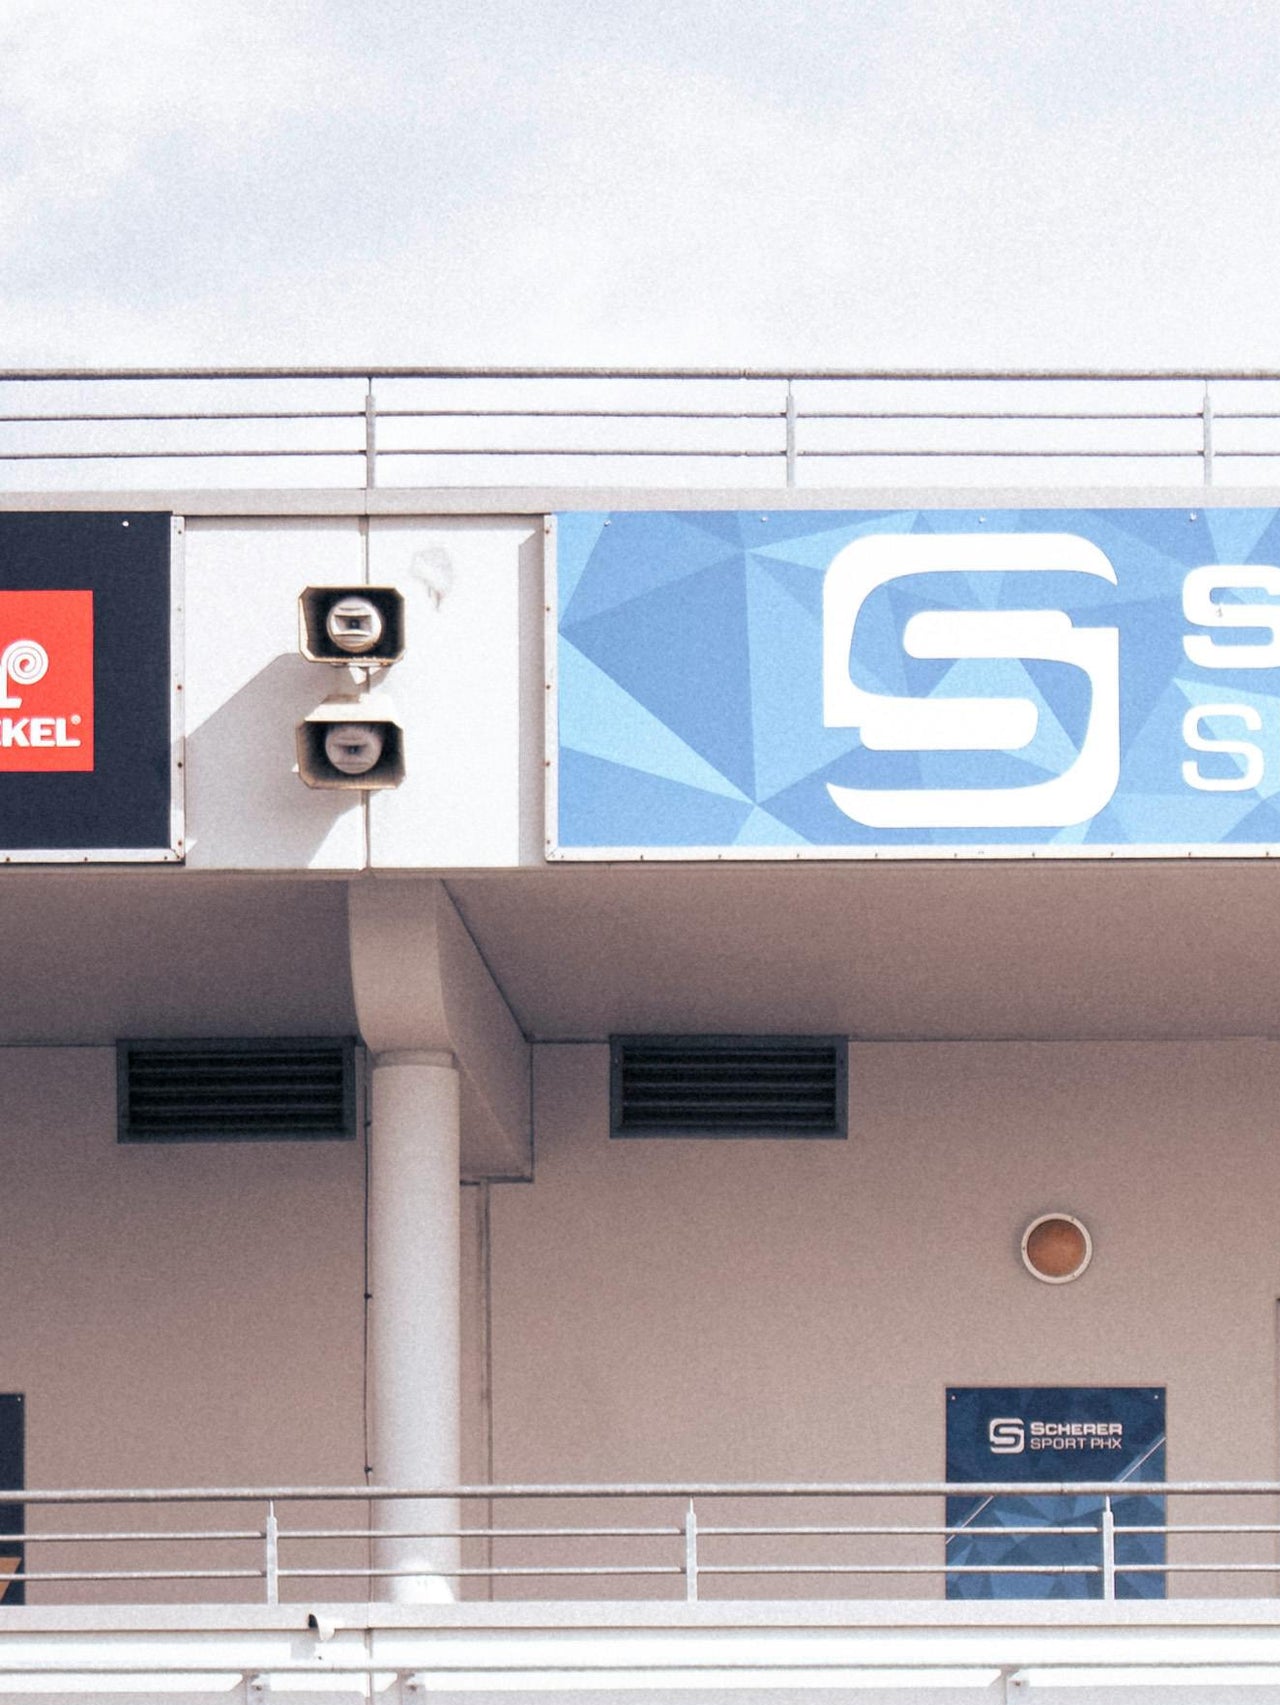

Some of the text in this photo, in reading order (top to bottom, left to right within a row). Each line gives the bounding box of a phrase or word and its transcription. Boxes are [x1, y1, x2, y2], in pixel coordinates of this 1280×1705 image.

[1030, 1421, 1123, 1436] SCHERER
[1030, 1437, 1122, 1450] SPORT PHX
